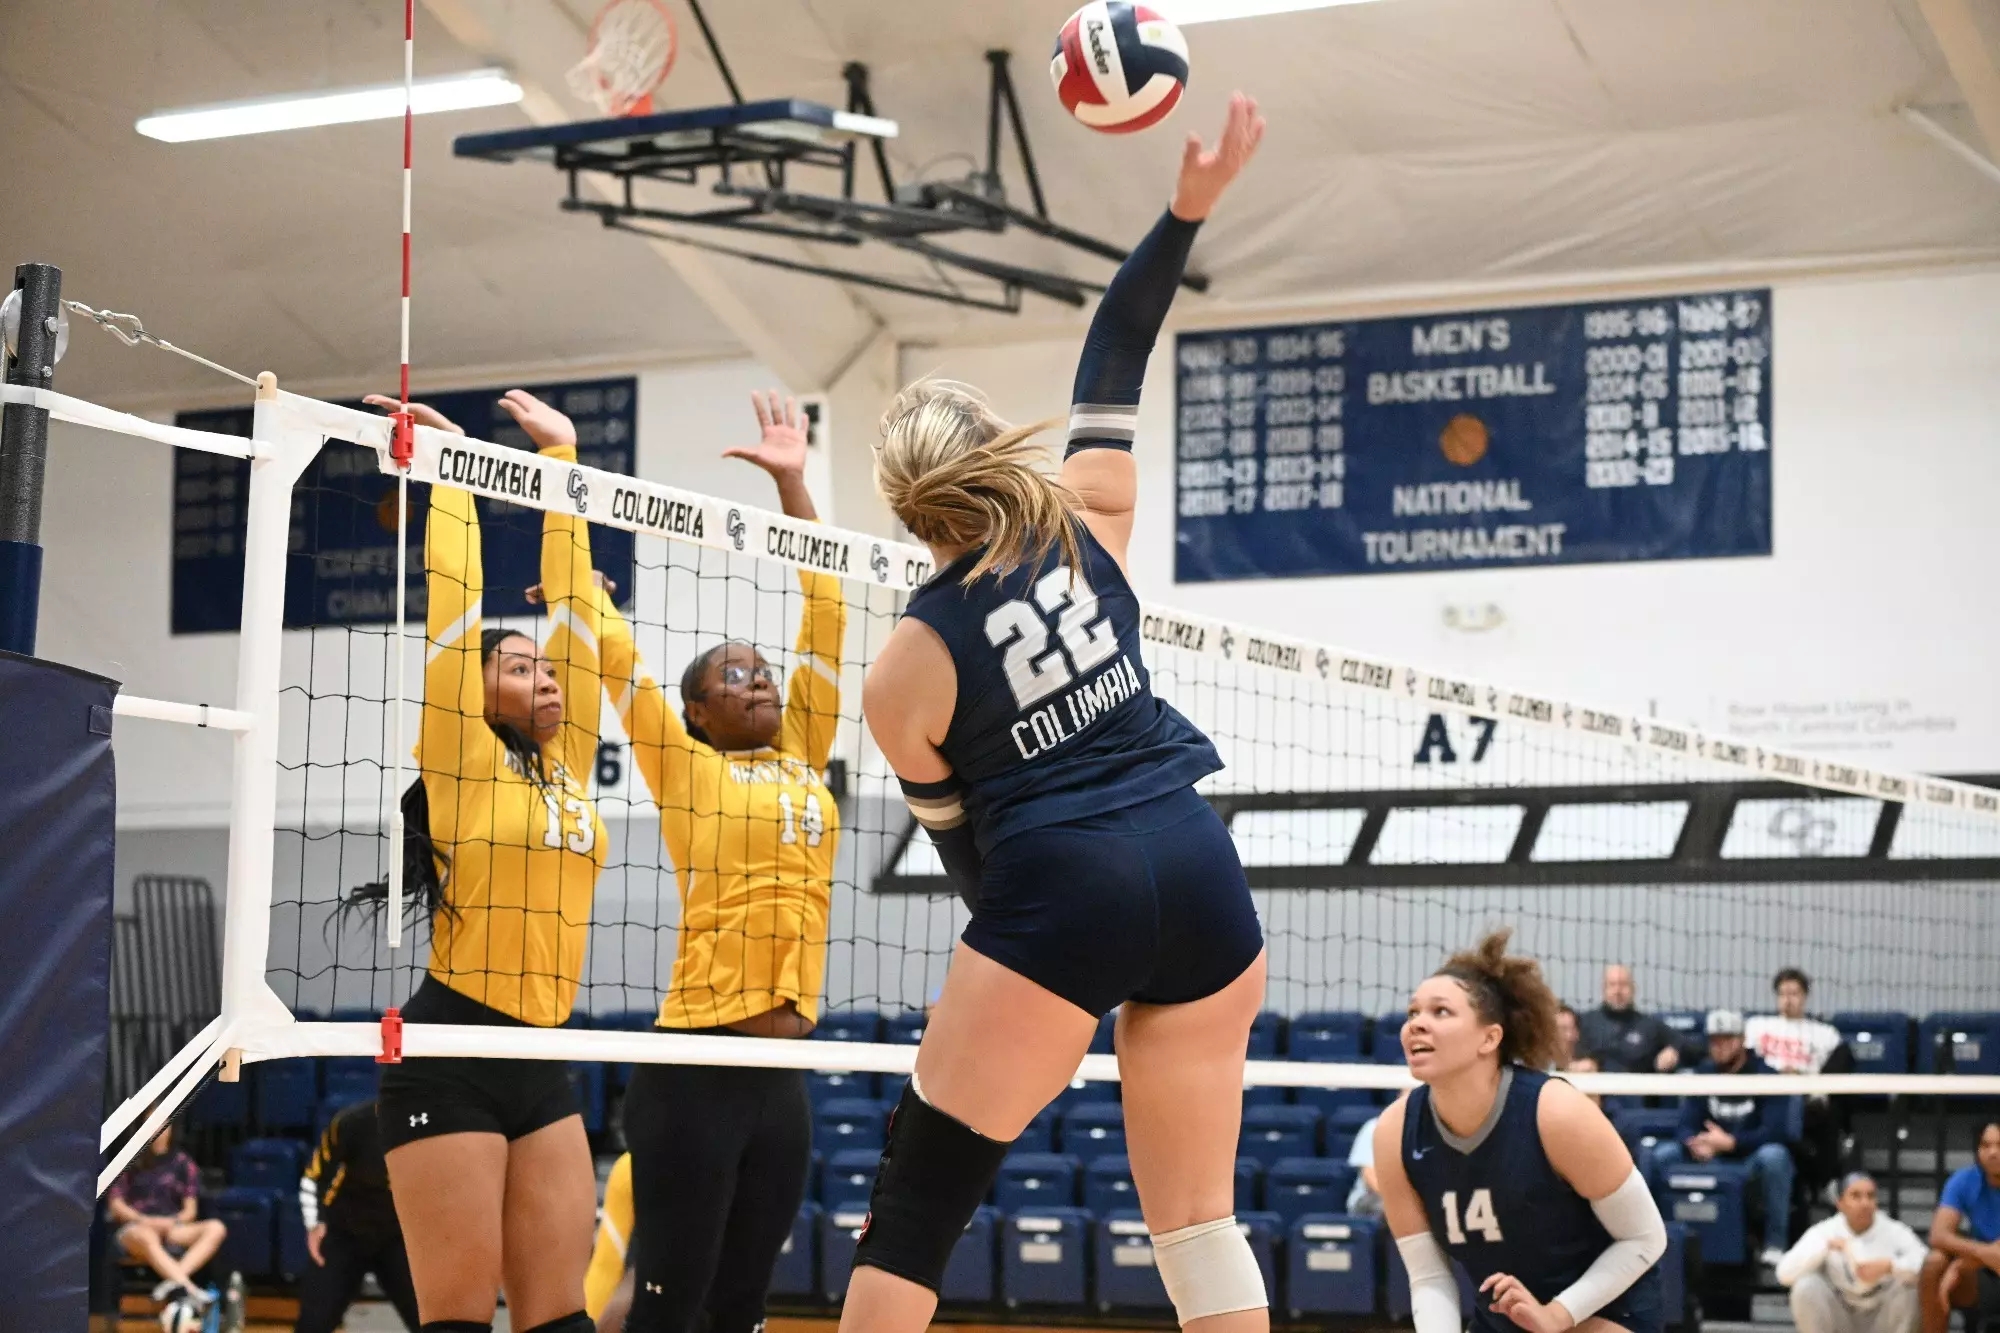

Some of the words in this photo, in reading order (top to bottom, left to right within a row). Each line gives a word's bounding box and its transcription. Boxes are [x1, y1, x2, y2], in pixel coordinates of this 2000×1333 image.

[1411, 318, 1511, 356] MEN'S
[1366, 361, 1557, 405] BASKETBALL
[438, 447, 542, 501] COLUMBIA
[612, 488, 704, 539] COLUMBIA
[767, 525, 849, 573] COLUMBIA
[1392, 477, 1533, 518] NATIONAL
[1361, 522, 1567, 564] TOURNAMENT
[983, 565, 1120, 712] 22
[1143, 614, 1205, 653] COLUMBIA
[1246, 637, 1303, 674] COLUMBIA
[1340, 658, 1393, 690] COLUMBIA
[1011, 654, 1142, 761] COLUMBIA
[543, 792, 596, 855] 13
[778, 791, 824, 847] 14
[1441, 1187, 1504, 1245] 14
